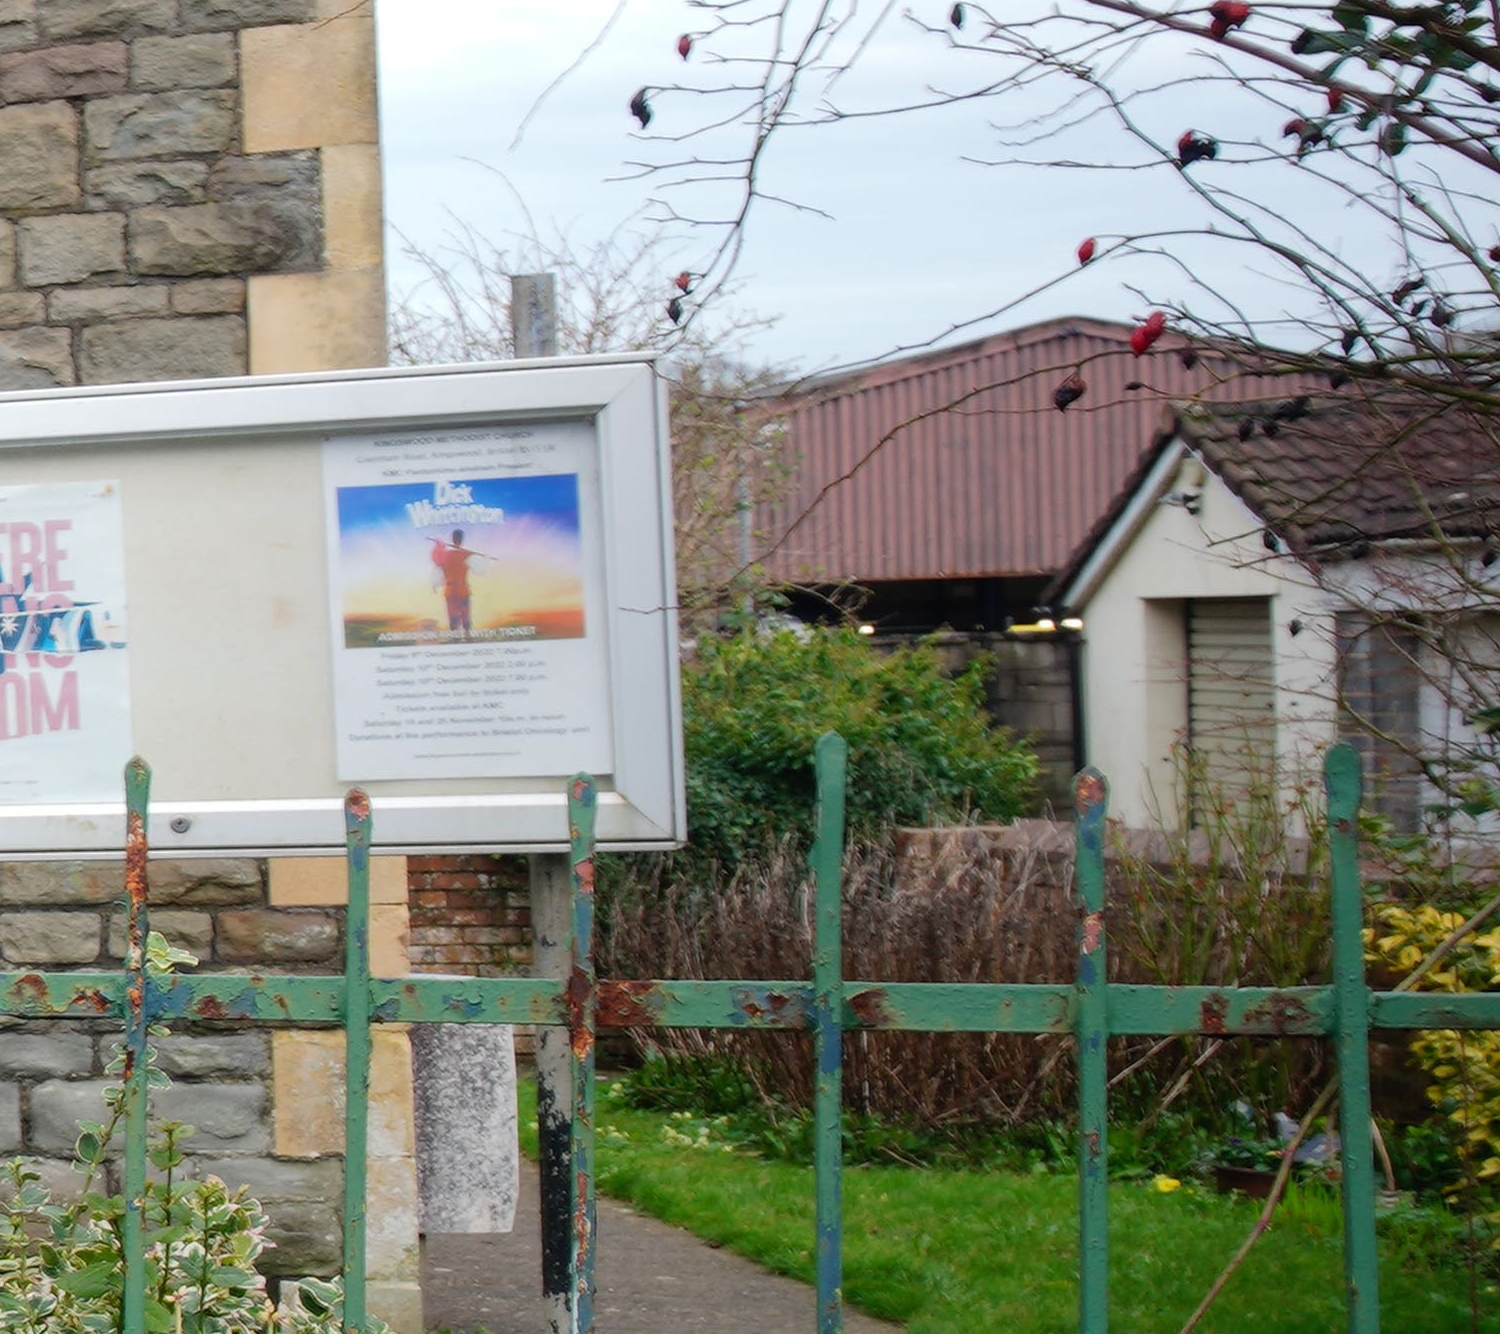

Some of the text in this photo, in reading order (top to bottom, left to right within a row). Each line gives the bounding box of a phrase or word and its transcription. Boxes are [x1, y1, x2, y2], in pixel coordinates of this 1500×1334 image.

[435, 478, 474, 505] Dick
[404, 499, 504, 529] Whittington
[377, 631, 438, 643] ADMISSION
[469, 627, 496, 639] WITH
[498, 626, 537, 637] TICKET
[425, 649, 470, 658] December
[376, 665, 415, 674] Saturday
[436, 662, 481, 671] December
[376, 678, 415, 687] Saturday
[436, 676, 481, 685] December
[449, 715, 494, 724] November
[348, 732, 392, 741] Donations
